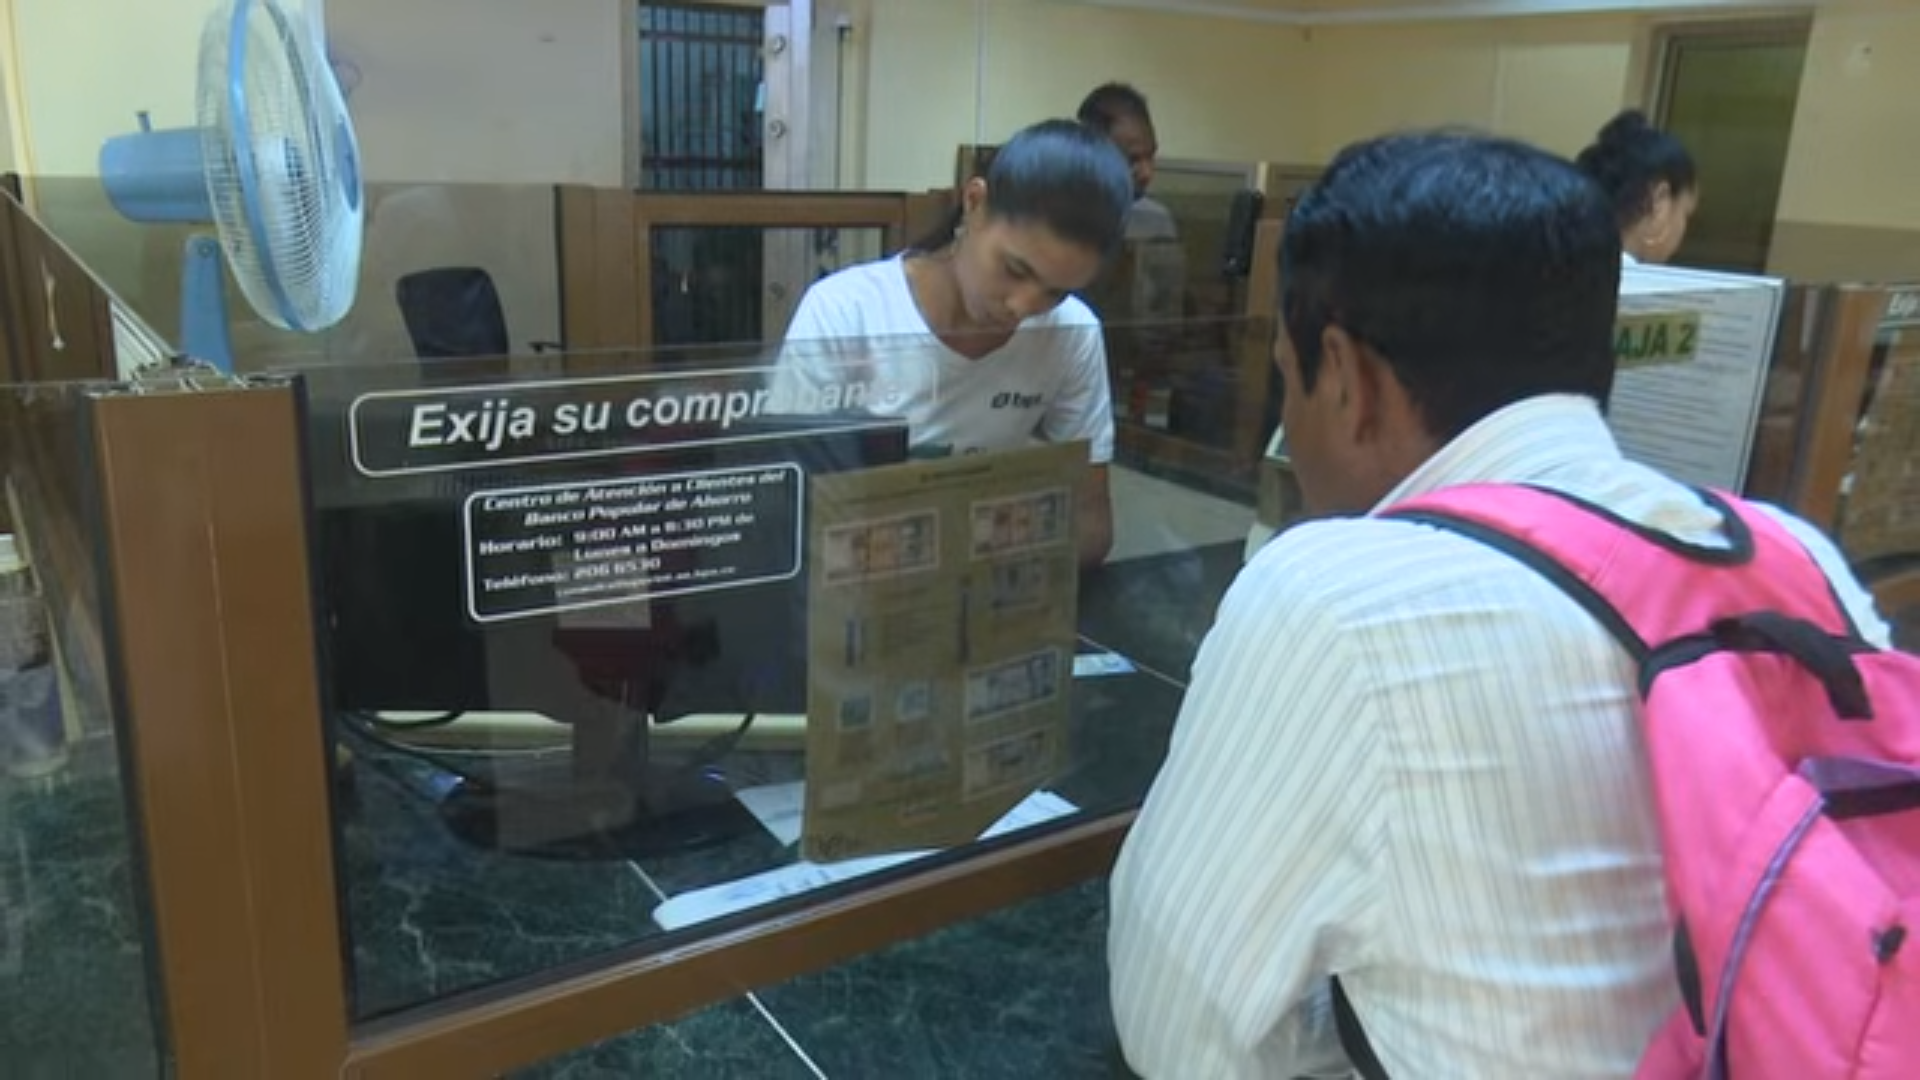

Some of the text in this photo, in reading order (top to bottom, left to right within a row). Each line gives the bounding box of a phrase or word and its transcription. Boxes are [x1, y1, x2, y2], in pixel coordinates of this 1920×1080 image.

[1615, 324, 1668, 360] AJA
[1676, 322, 1696, 354] 2
[409, 399, 536, 450] Exija
[552, 401, 611, 434] su
[484, 469, 786, 511] Centro de Atención a Clientes del
[524, 493, 752, 526] Banco Popular de Ahorro
[478, 534, 563, 556] Horario:
[573, 527, 616, 544] 9:00
[621, 524, 646, 537] AM
[650, 524, 661, 534] a
[707, 515, 733, 528] PM
[734, 513, 754, 525] de
[574, 532, 742, 562] Lunes a Domingos
[484, 571, 569, 592] Teléfono:
